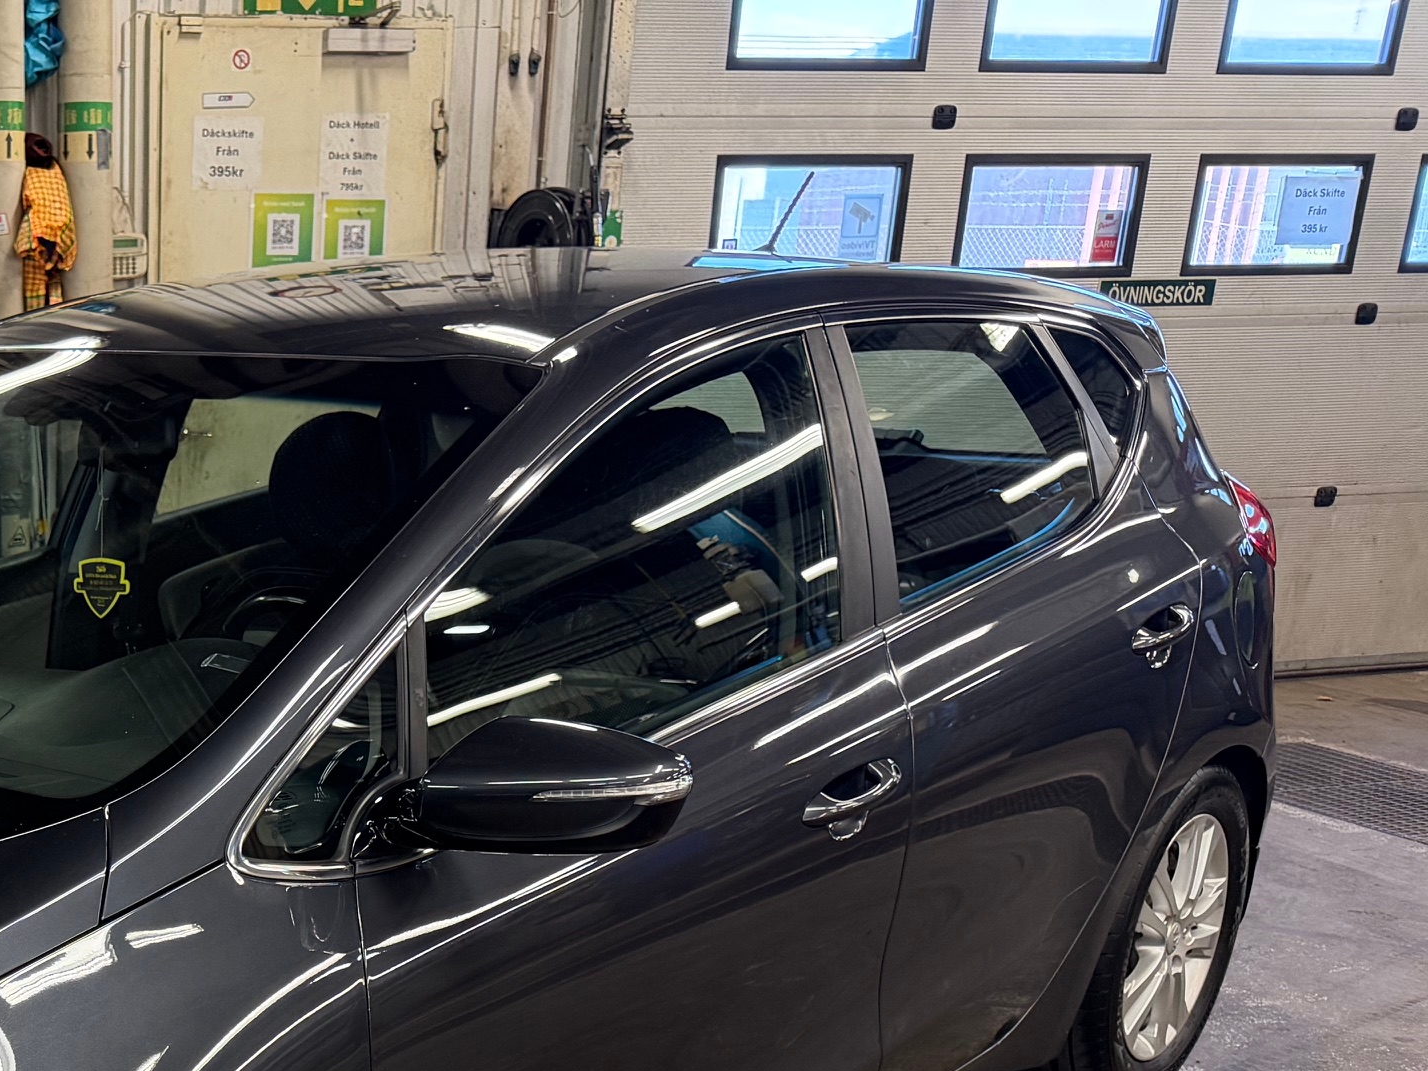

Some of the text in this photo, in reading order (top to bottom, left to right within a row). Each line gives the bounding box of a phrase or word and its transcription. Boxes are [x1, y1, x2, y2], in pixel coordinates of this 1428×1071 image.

[329, 120, 380, 129] Däck Hotell
[202, 128, 254, 138] Däckskifte
[215, 145, 239, 156] Från
[352, 151, 378, 160] Skifte
[209, 165, 244, 177] 395kr
[343, 166, 362, 176] Från
[1295, 188, 1346, 198] Däck Skifte
[1307, 205, 1327, 216] Från
[1301, 224, 1328, 234] 395 kr
[1094, 240, 1116, 248] LARM
[1108, 282, 1206, 304] ÖVNINGSKÖR
